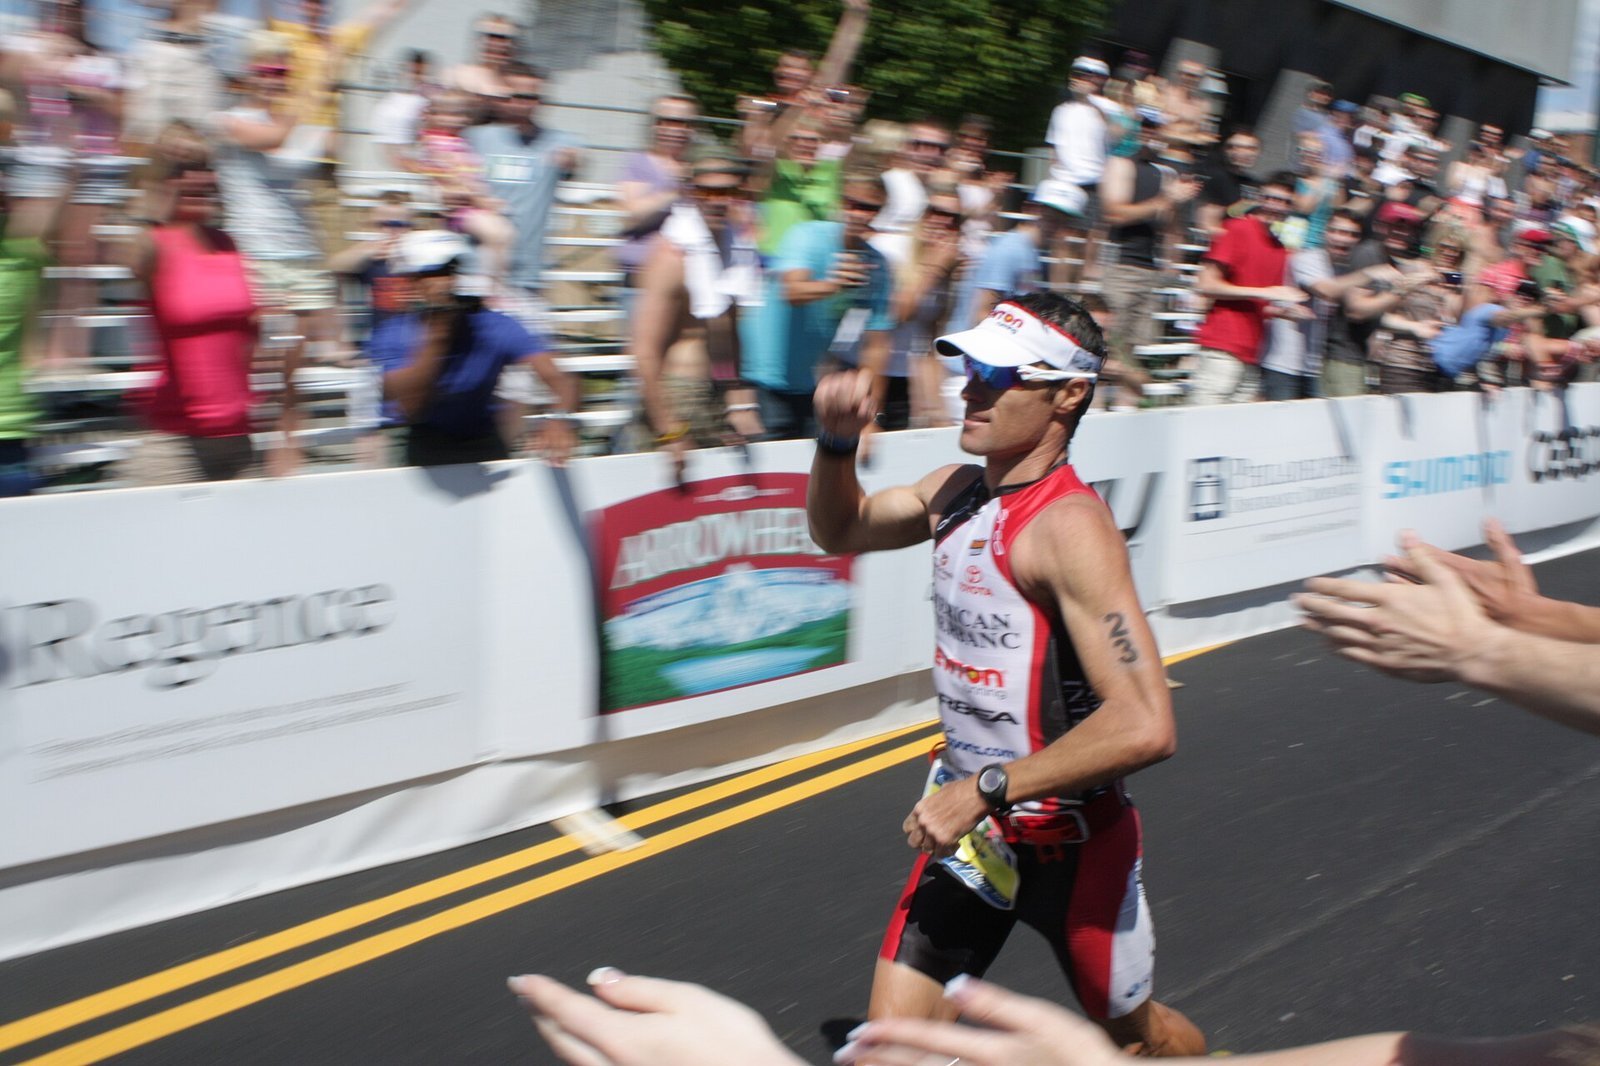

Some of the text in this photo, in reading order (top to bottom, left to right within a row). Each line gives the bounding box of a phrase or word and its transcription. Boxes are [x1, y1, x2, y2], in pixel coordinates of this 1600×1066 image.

[609, 506, 827, 591] ARROWHE
[8, 582, 396, 691] Regence
[1103, 612, 1139, 663] 23
